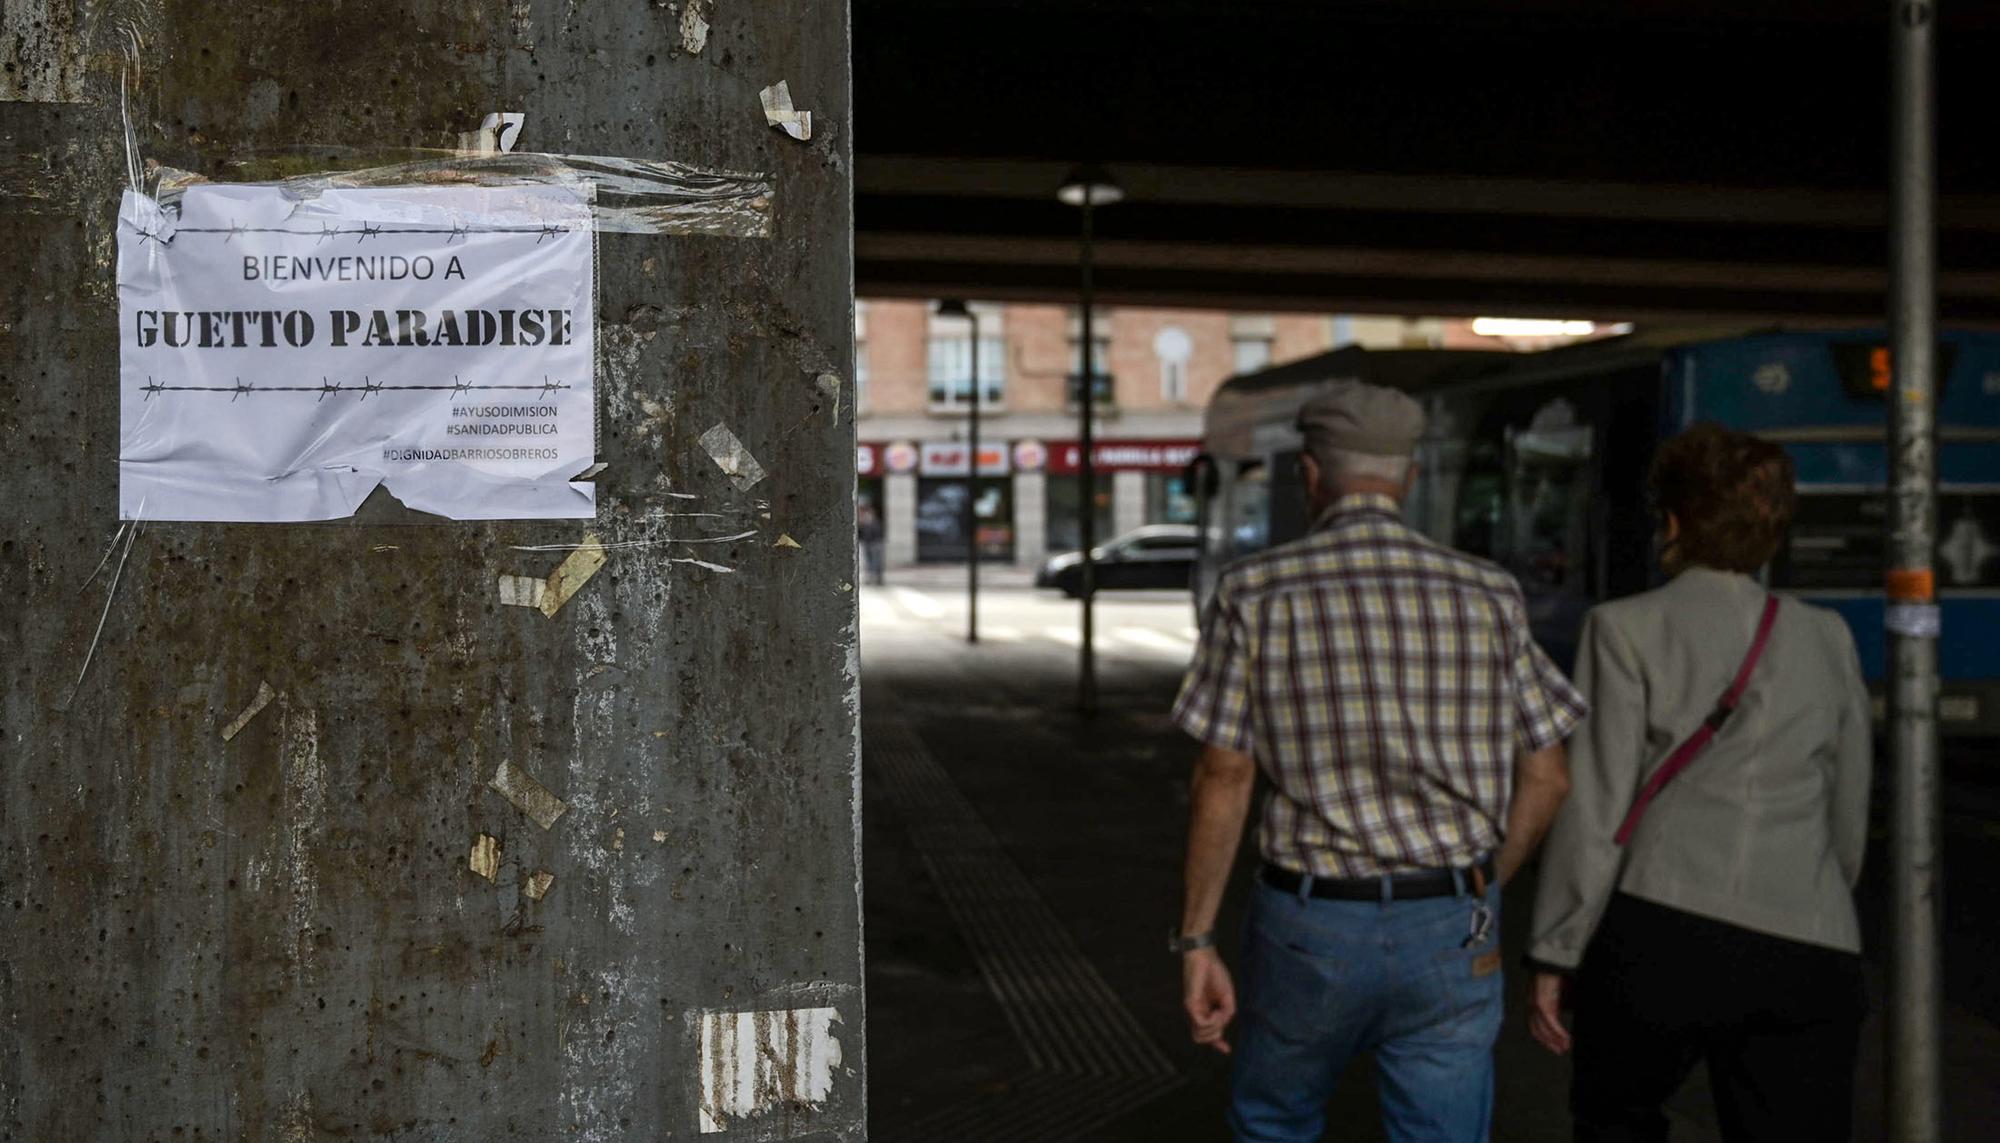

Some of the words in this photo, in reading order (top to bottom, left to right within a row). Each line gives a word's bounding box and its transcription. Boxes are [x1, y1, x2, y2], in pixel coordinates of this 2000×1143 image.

[244, 255, 434, 281] BIENVENIDO
[444, 255, 465, 281] A
[137, 310, 314, 348] GUETTO
[330, 309, 571, 347] PARADISE
[452, 406, 558, 418] #AYUSODIMISION
[447, 424, 558, 436] #SANIDADPUBLICA
